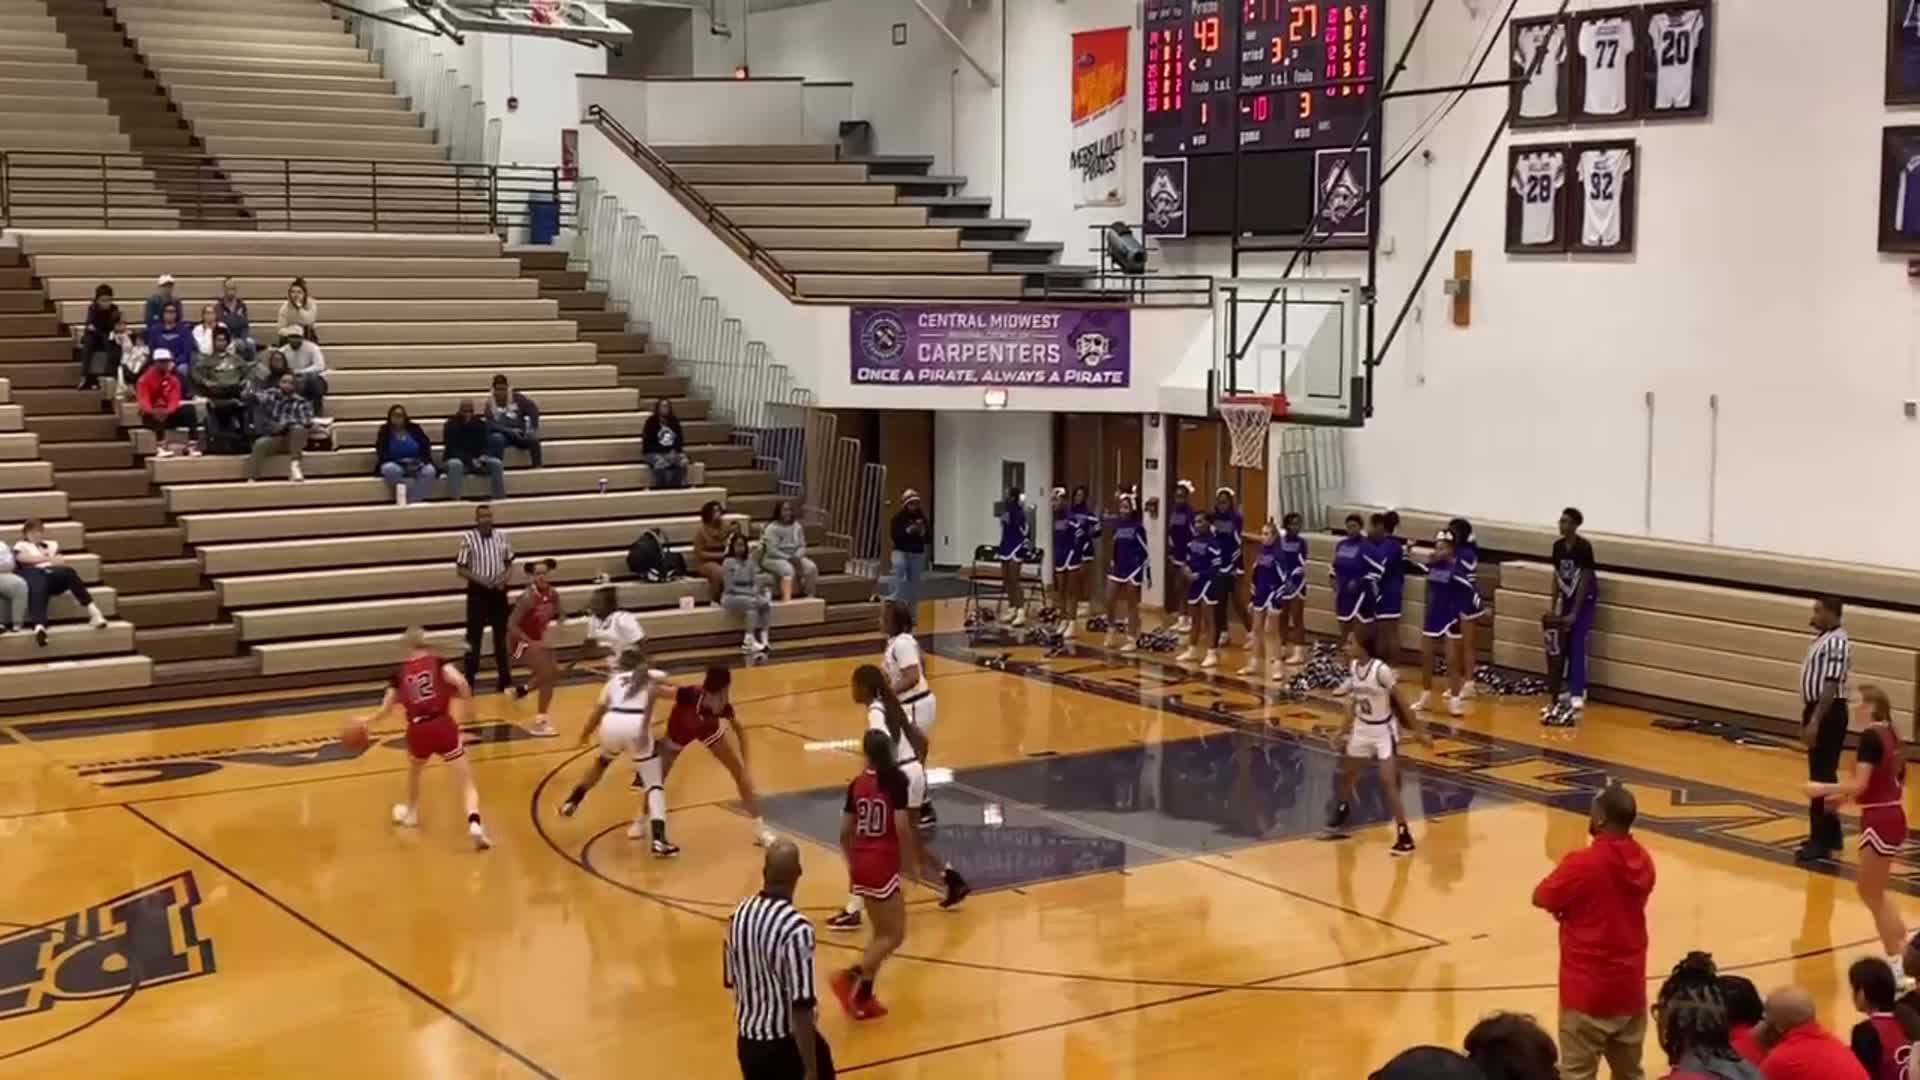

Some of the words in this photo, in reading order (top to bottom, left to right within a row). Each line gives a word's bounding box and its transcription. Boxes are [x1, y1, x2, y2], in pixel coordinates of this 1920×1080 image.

[1194, 17, 1219, 52] 43
[1288, 4, 1318, 42] 27
[1595, 39, 1620, 70] 77
[1660, 30, 1690, 67] 20
[1299, 91, 1312, 118] 3
[1526, 173, 1552, 203] 28
[1590, 171, 1614, 200] 92
[918, 313, 986, 329] CENTRAL
[990, 314, 1062, 329] MIDWEST
[917, 343, 1061, 364] CARPENTERS
[857, 367, 900, 382] ONCE
[903, 368, 915, 382] A
[981, 369, 1045, 383] ALWAYS
[1048, 369, 1060, 384] A
[1063, 369, 1124, 385] PIRATE
